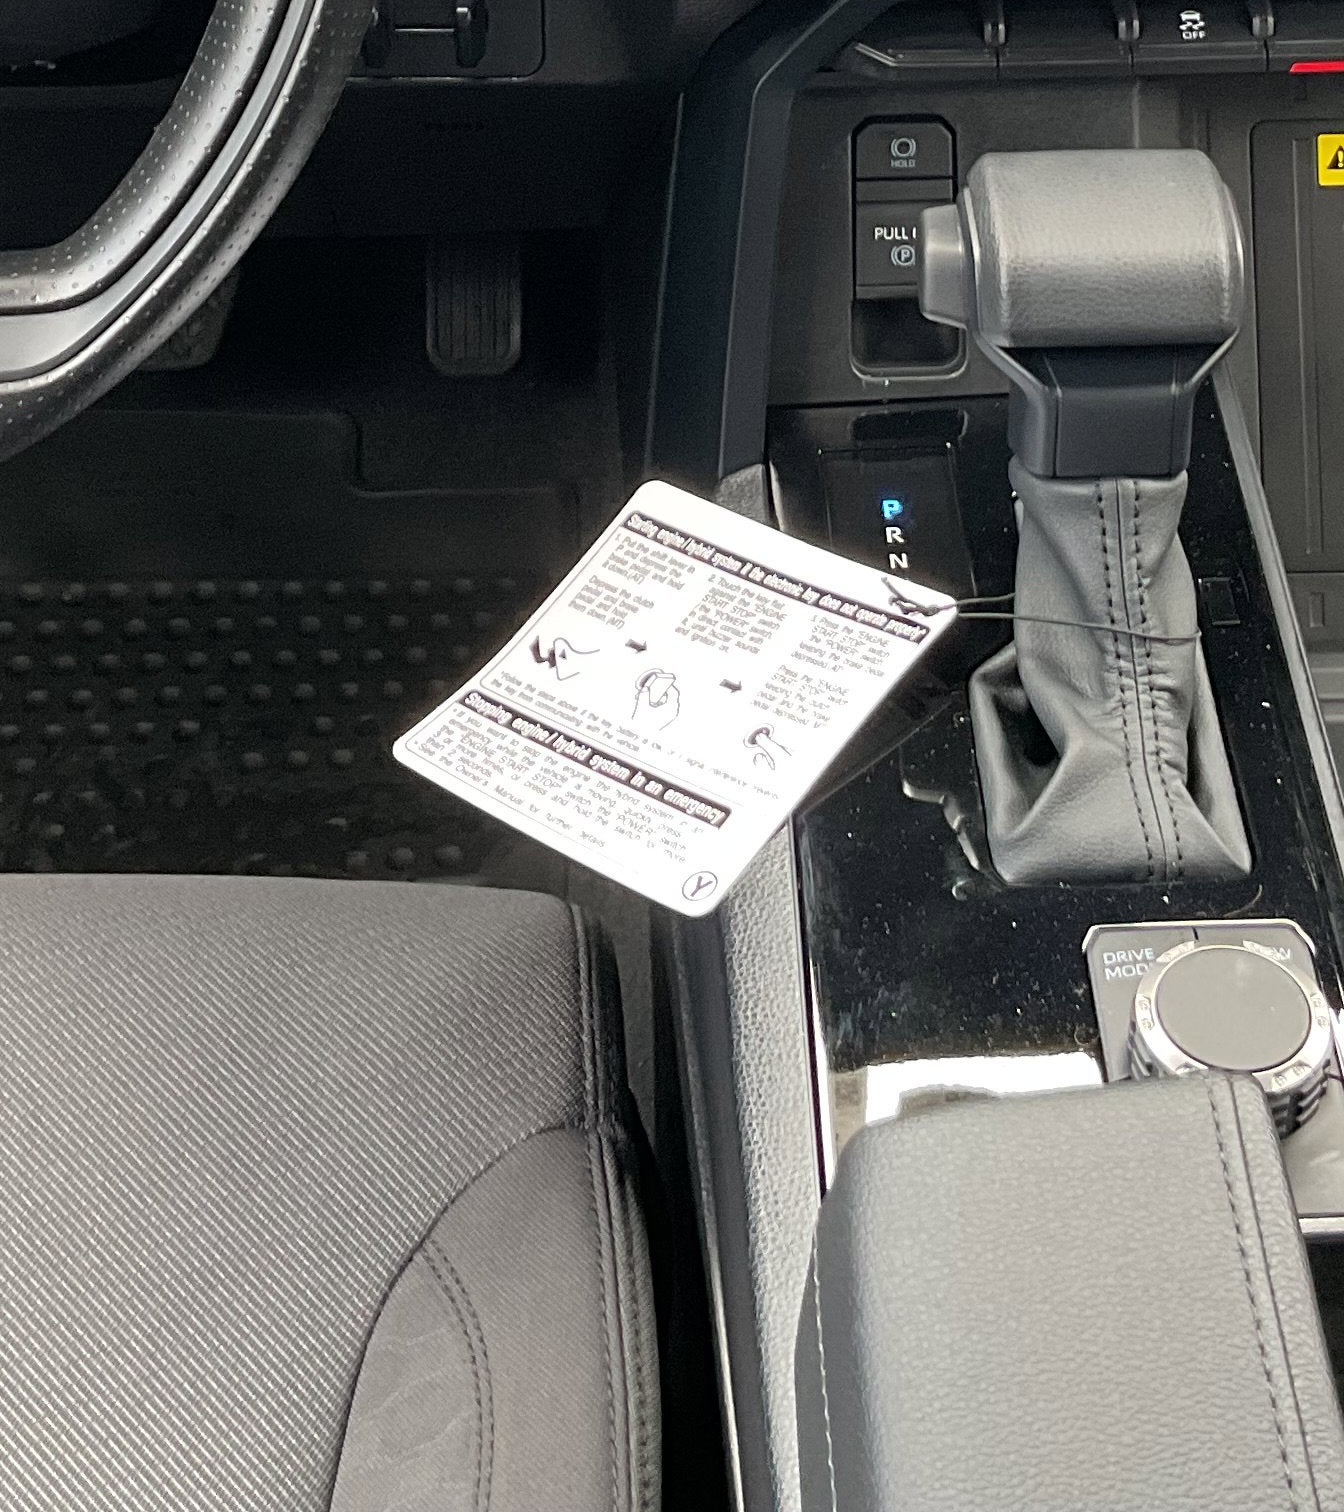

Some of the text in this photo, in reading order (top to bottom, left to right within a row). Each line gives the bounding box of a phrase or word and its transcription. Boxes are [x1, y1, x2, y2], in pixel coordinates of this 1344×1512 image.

[1181, 30, 1206, 40] OFF
[874, 227, 909, 241] PULL
[881, 498, 903, 520] P
[885, 525, 905, 544] R
[888, 552, 909, 570] N
[461, 691, 515, 725] Stopping
[585, 752, 633, 783] system
[628, 771, 648, 788] in
[643, 780, 663, 795] an
[659, 786, 726, 827] emergency
[690, 875, 714, 898] Y
[1102, 947, 1154, 966] DRIVE
